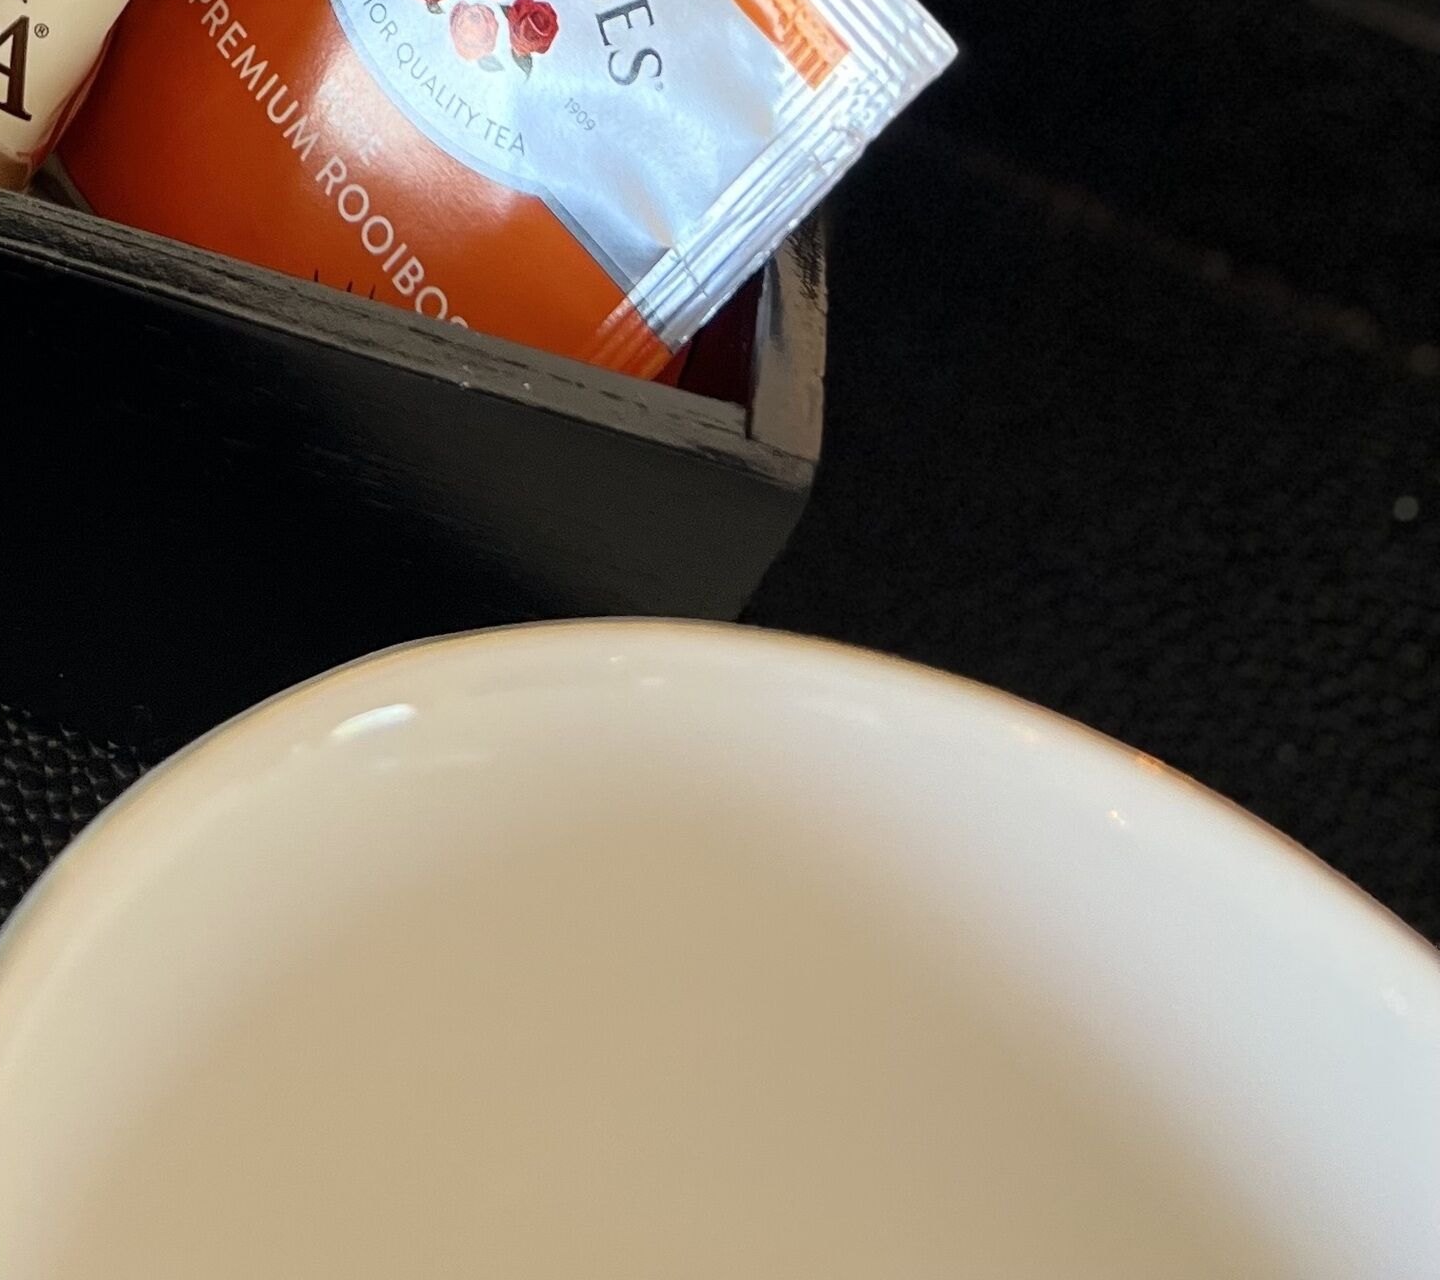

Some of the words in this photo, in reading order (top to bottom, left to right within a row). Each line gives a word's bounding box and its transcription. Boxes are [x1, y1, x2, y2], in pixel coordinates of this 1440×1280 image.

[396, 42, 482, 128] QUALITY
[481, 117, 527, 157] TEA
[564, 97, 596, 132] 1909
